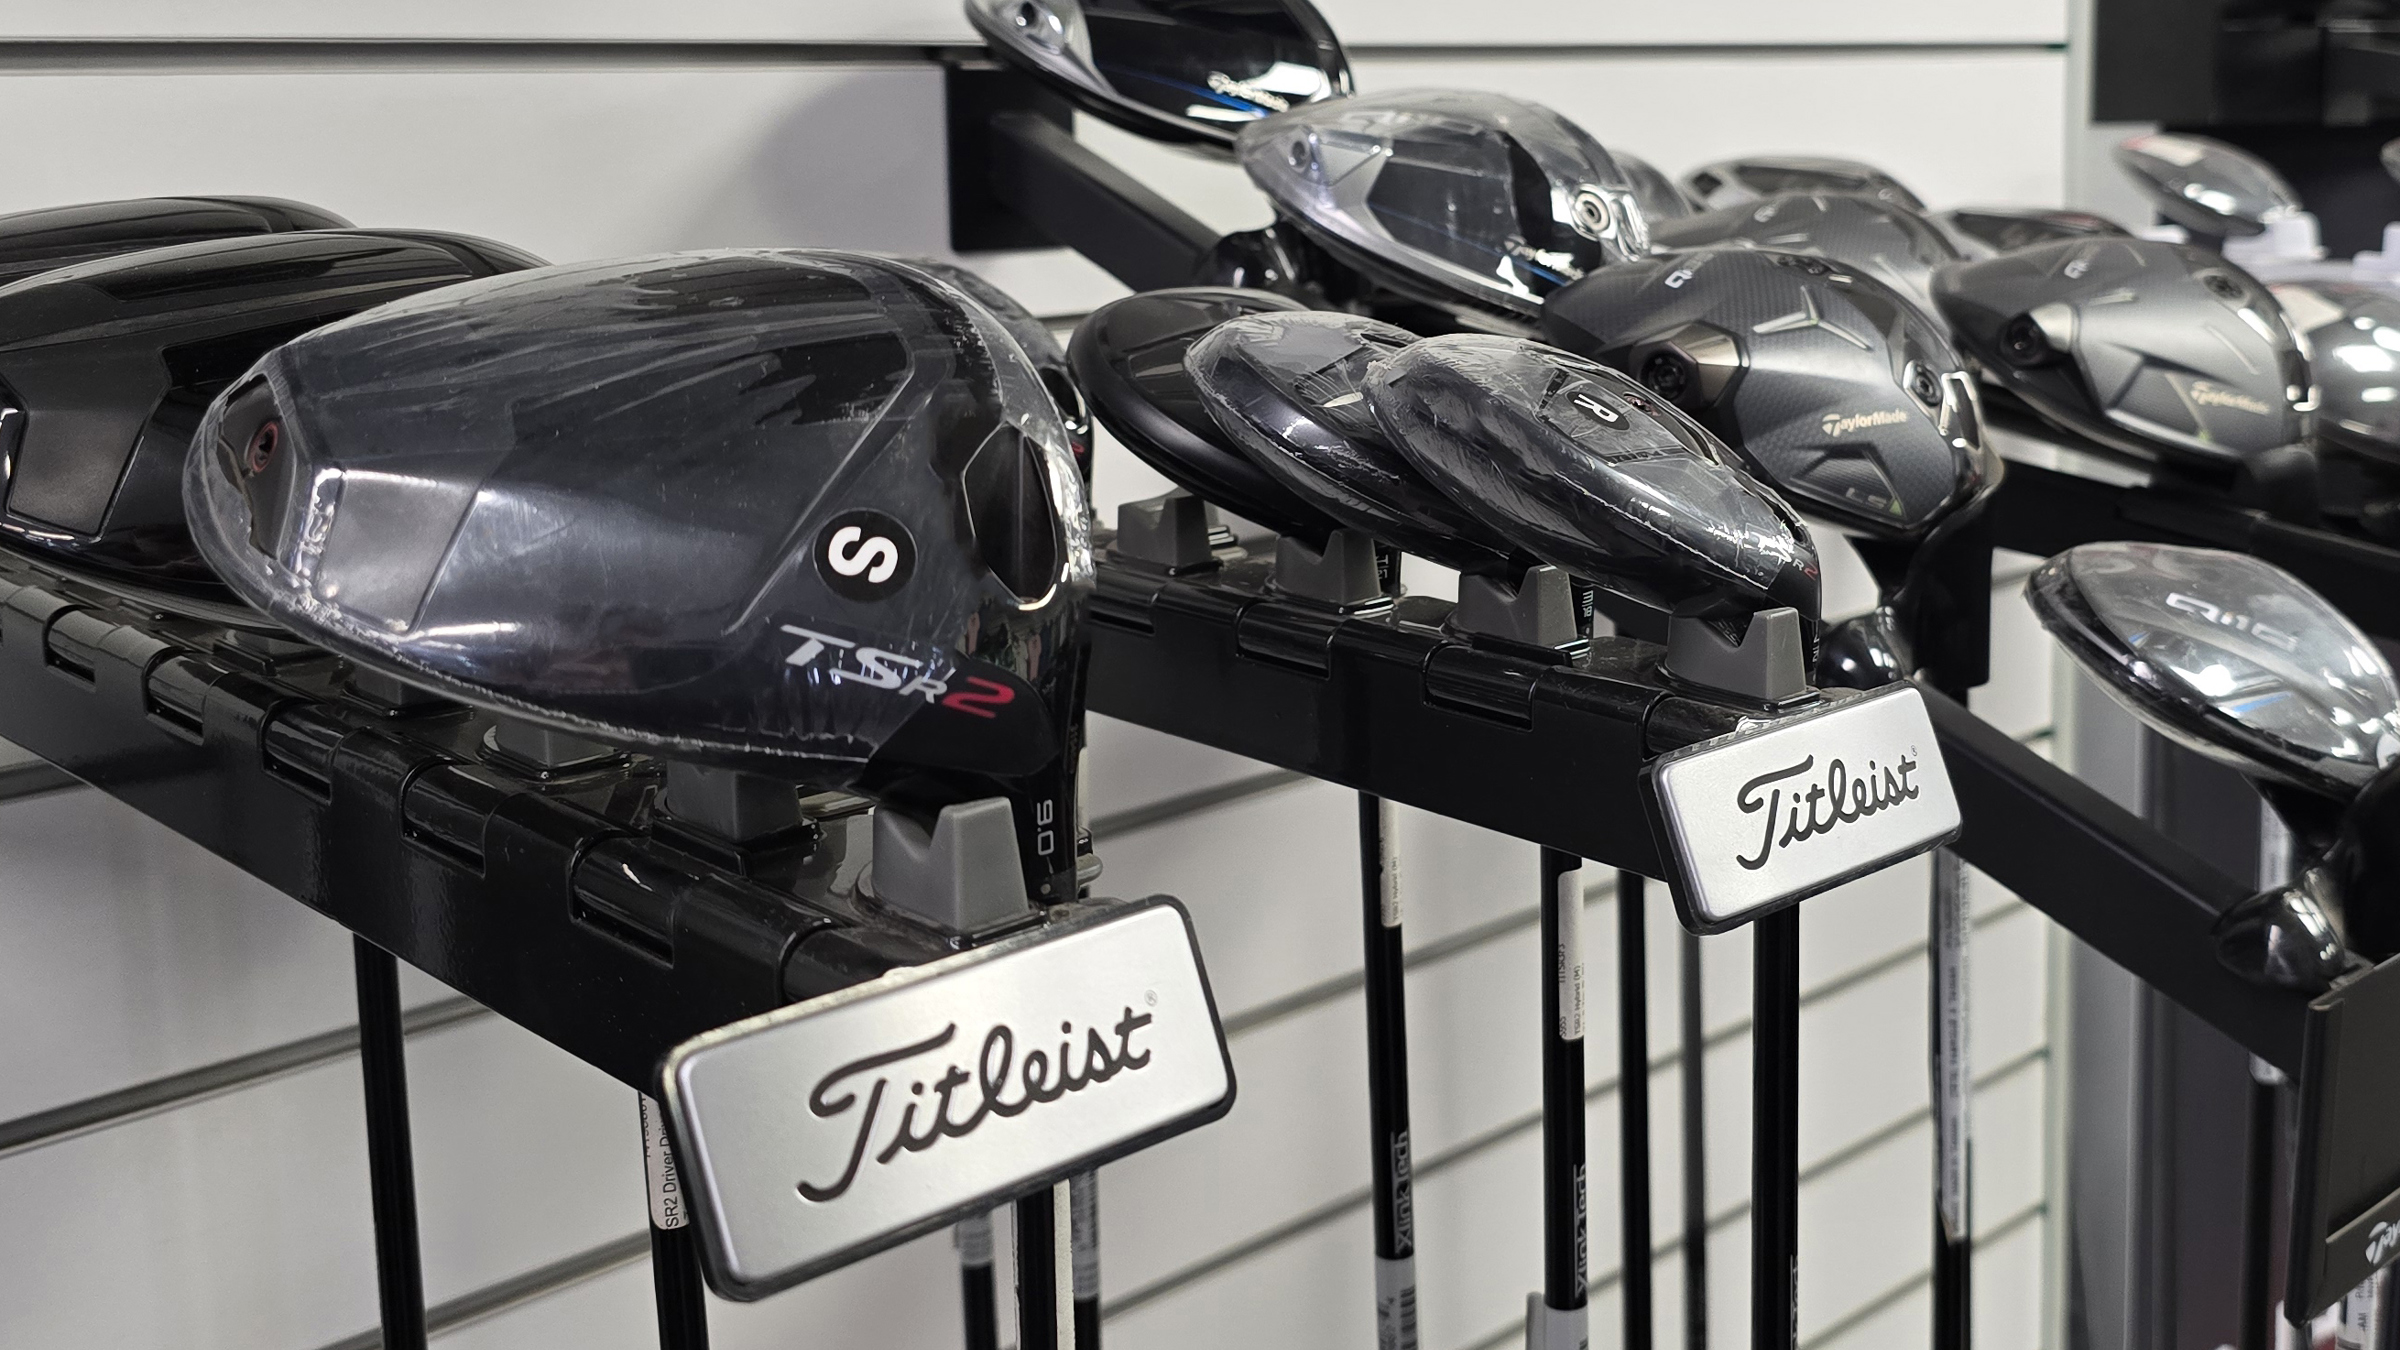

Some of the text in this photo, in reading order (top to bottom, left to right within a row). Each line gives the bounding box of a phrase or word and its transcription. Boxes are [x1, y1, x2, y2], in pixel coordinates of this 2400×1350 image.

[1573, 393, 1619, 422] R
[1822, 408, 1907, 437] TaylorMade
[828, 526, 898, 583] S
[780, 623, 1015, 719] TSR2
[1736, 754, 1920, 871] Titleist
[797, 1006, 1152, 1203] Titleist
[661, 1151, 677, 1194] Driver
